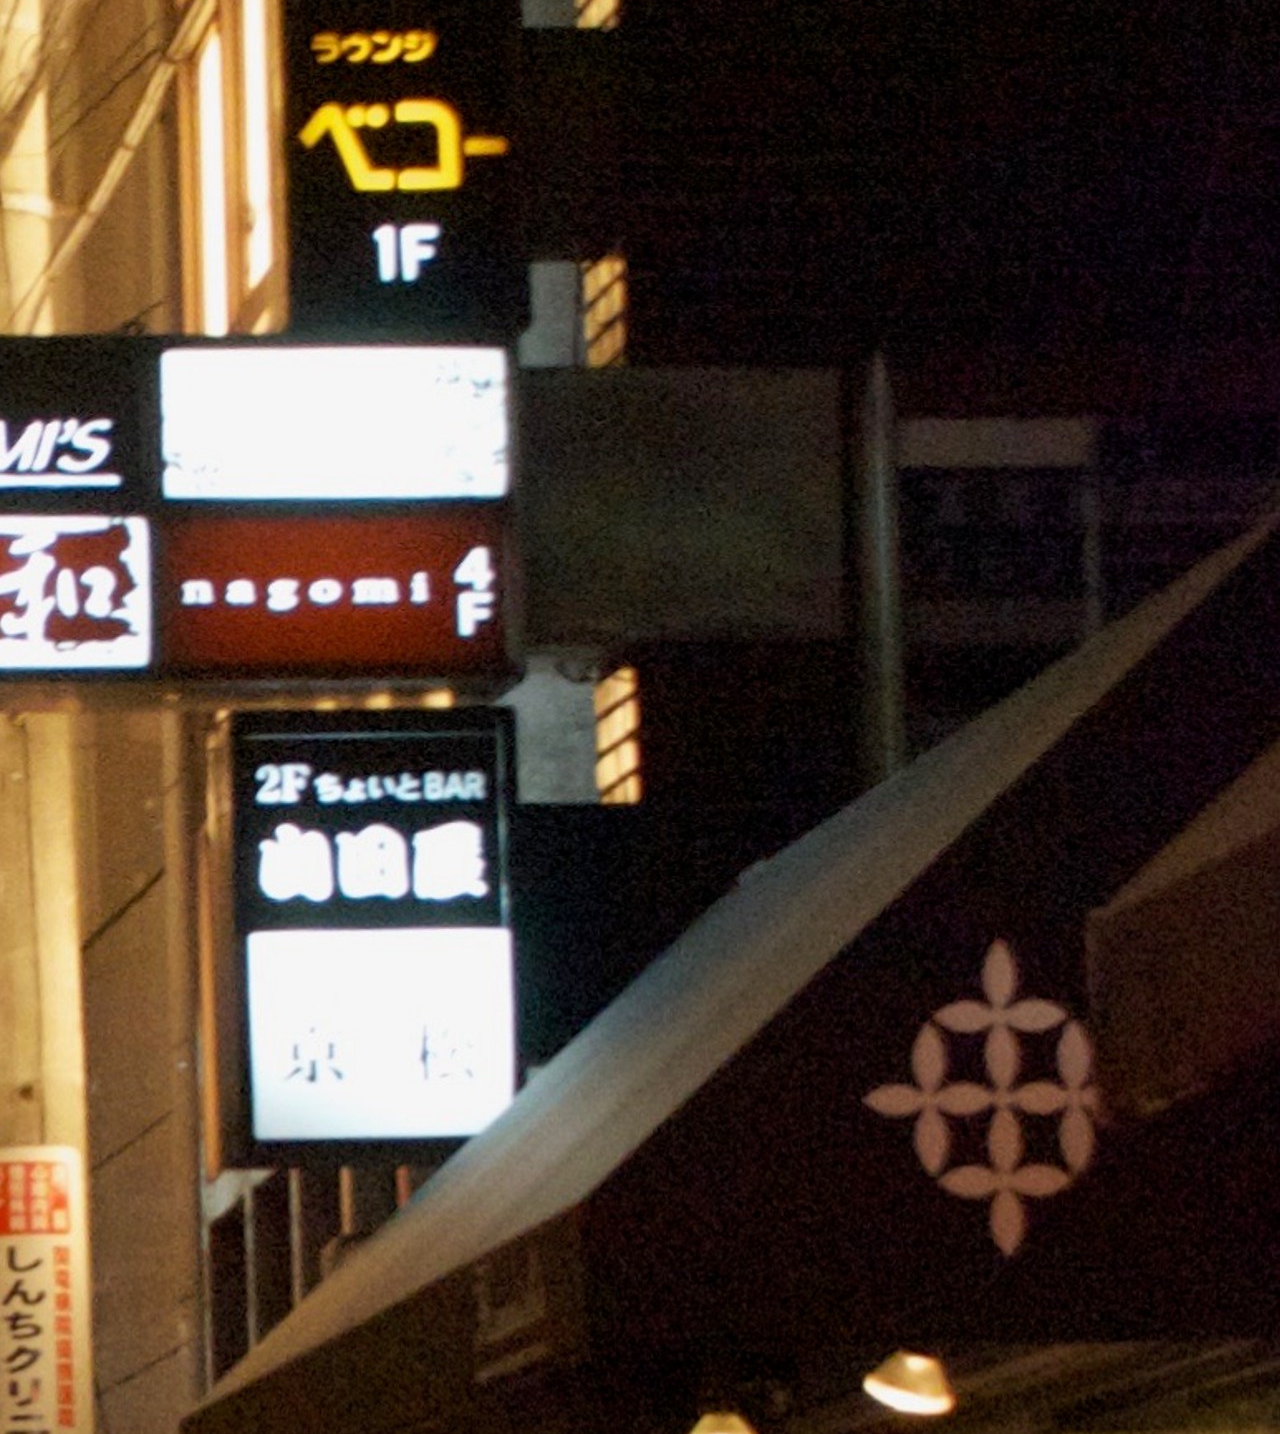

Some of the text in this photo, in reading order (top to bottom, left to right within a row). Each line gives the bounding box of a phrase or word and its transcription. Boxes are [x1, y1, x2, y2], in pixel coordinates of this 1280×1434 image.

[308, 30, 439, 64] ラウンジ
[371, 222, 441, 284] 1F
[181, 569, 431, 612] nagomi
[253, 763, 311, 805] 2F
